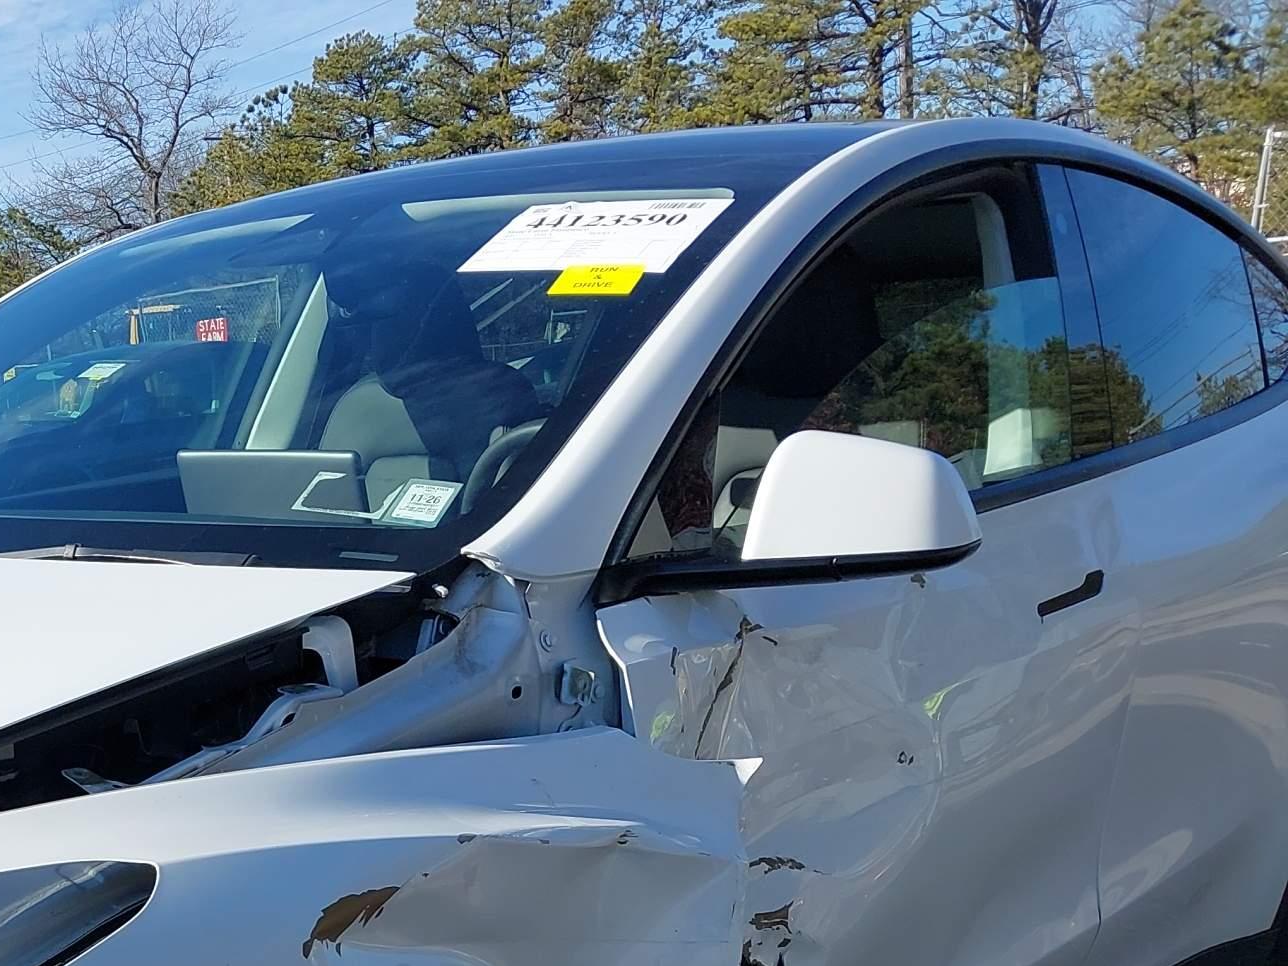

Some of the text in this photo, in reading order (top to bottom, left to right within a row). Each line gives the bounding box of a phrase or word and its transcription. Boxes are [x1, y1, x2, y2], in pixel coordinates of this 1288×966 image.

[526, 213, 688, 229] 44123590
[572, 281, 614, 289] DRIVE
[199, 318, 225, 332] STATE
